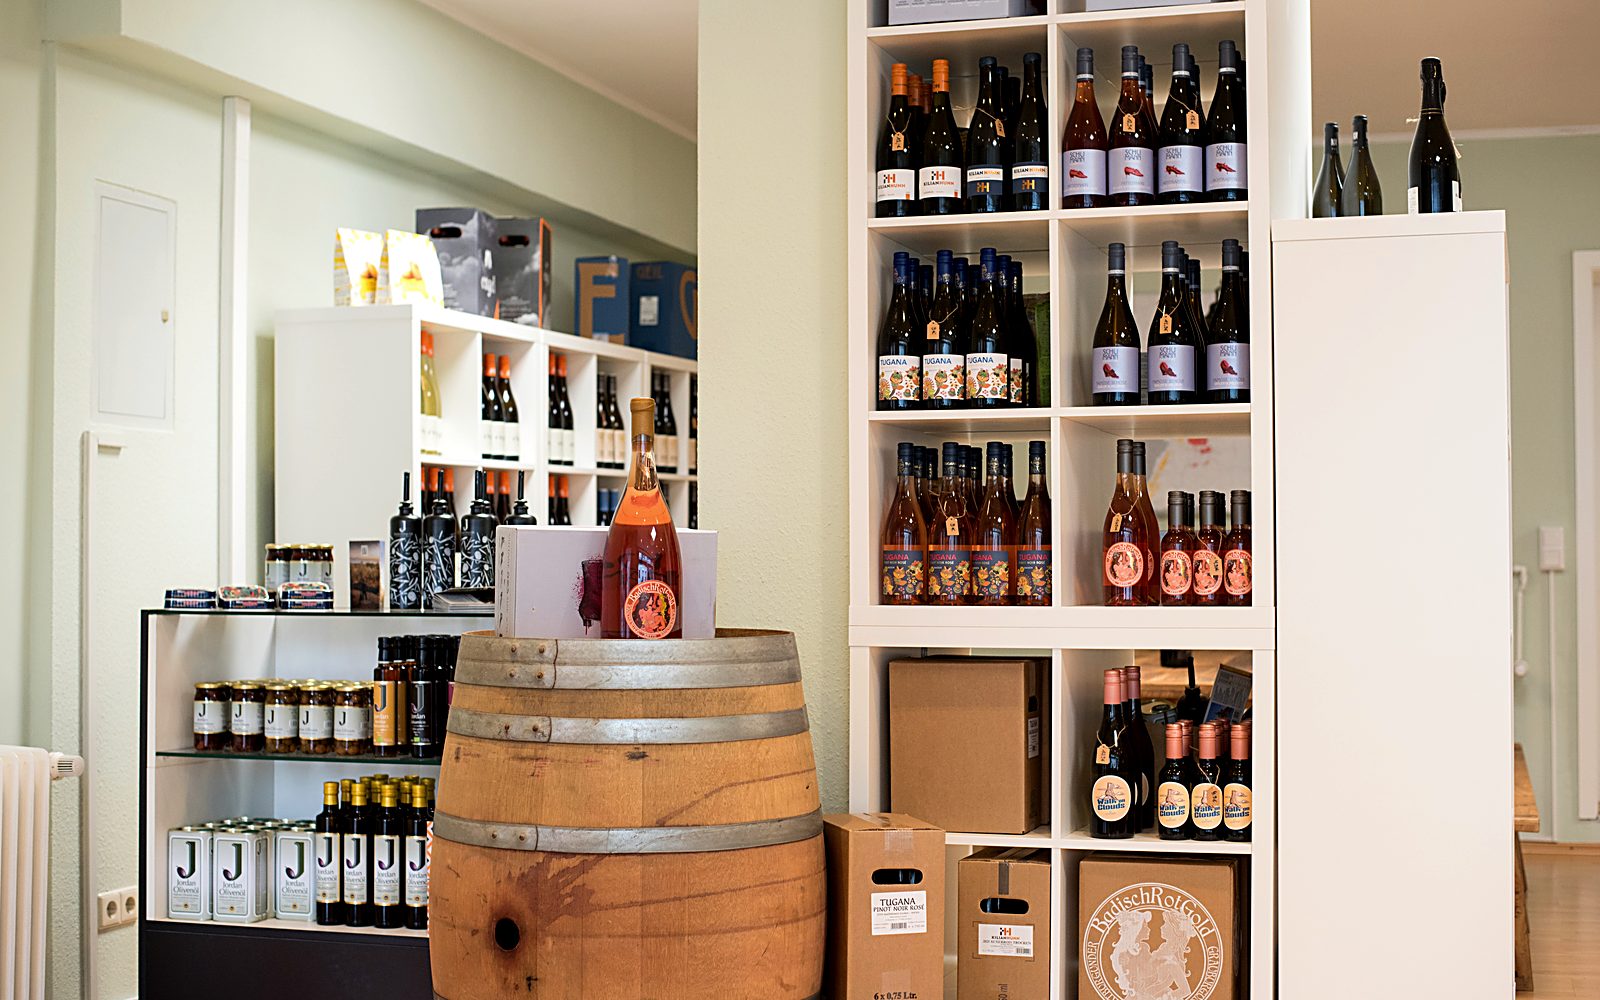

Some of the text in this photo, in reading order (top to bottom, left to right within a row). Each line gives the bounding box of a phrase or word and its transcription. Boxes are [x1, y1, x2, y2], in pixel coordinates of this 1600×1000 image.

[222, 881, 242, 889] Jordan
[173, 886, 199, 894] Olivenöl
[219, 888, 245, 896] Olivenöl
[282, 886, 308, 895] Olivenöl
[880, 897, 916, 907] TUGANA
[1091, 886, 1216, 937] BadischRotGold
[873, 992, 879, 1000] 6
[887, 992, 902, 1000] 0,75
[903, 992, 917, 1000] Ltr.
